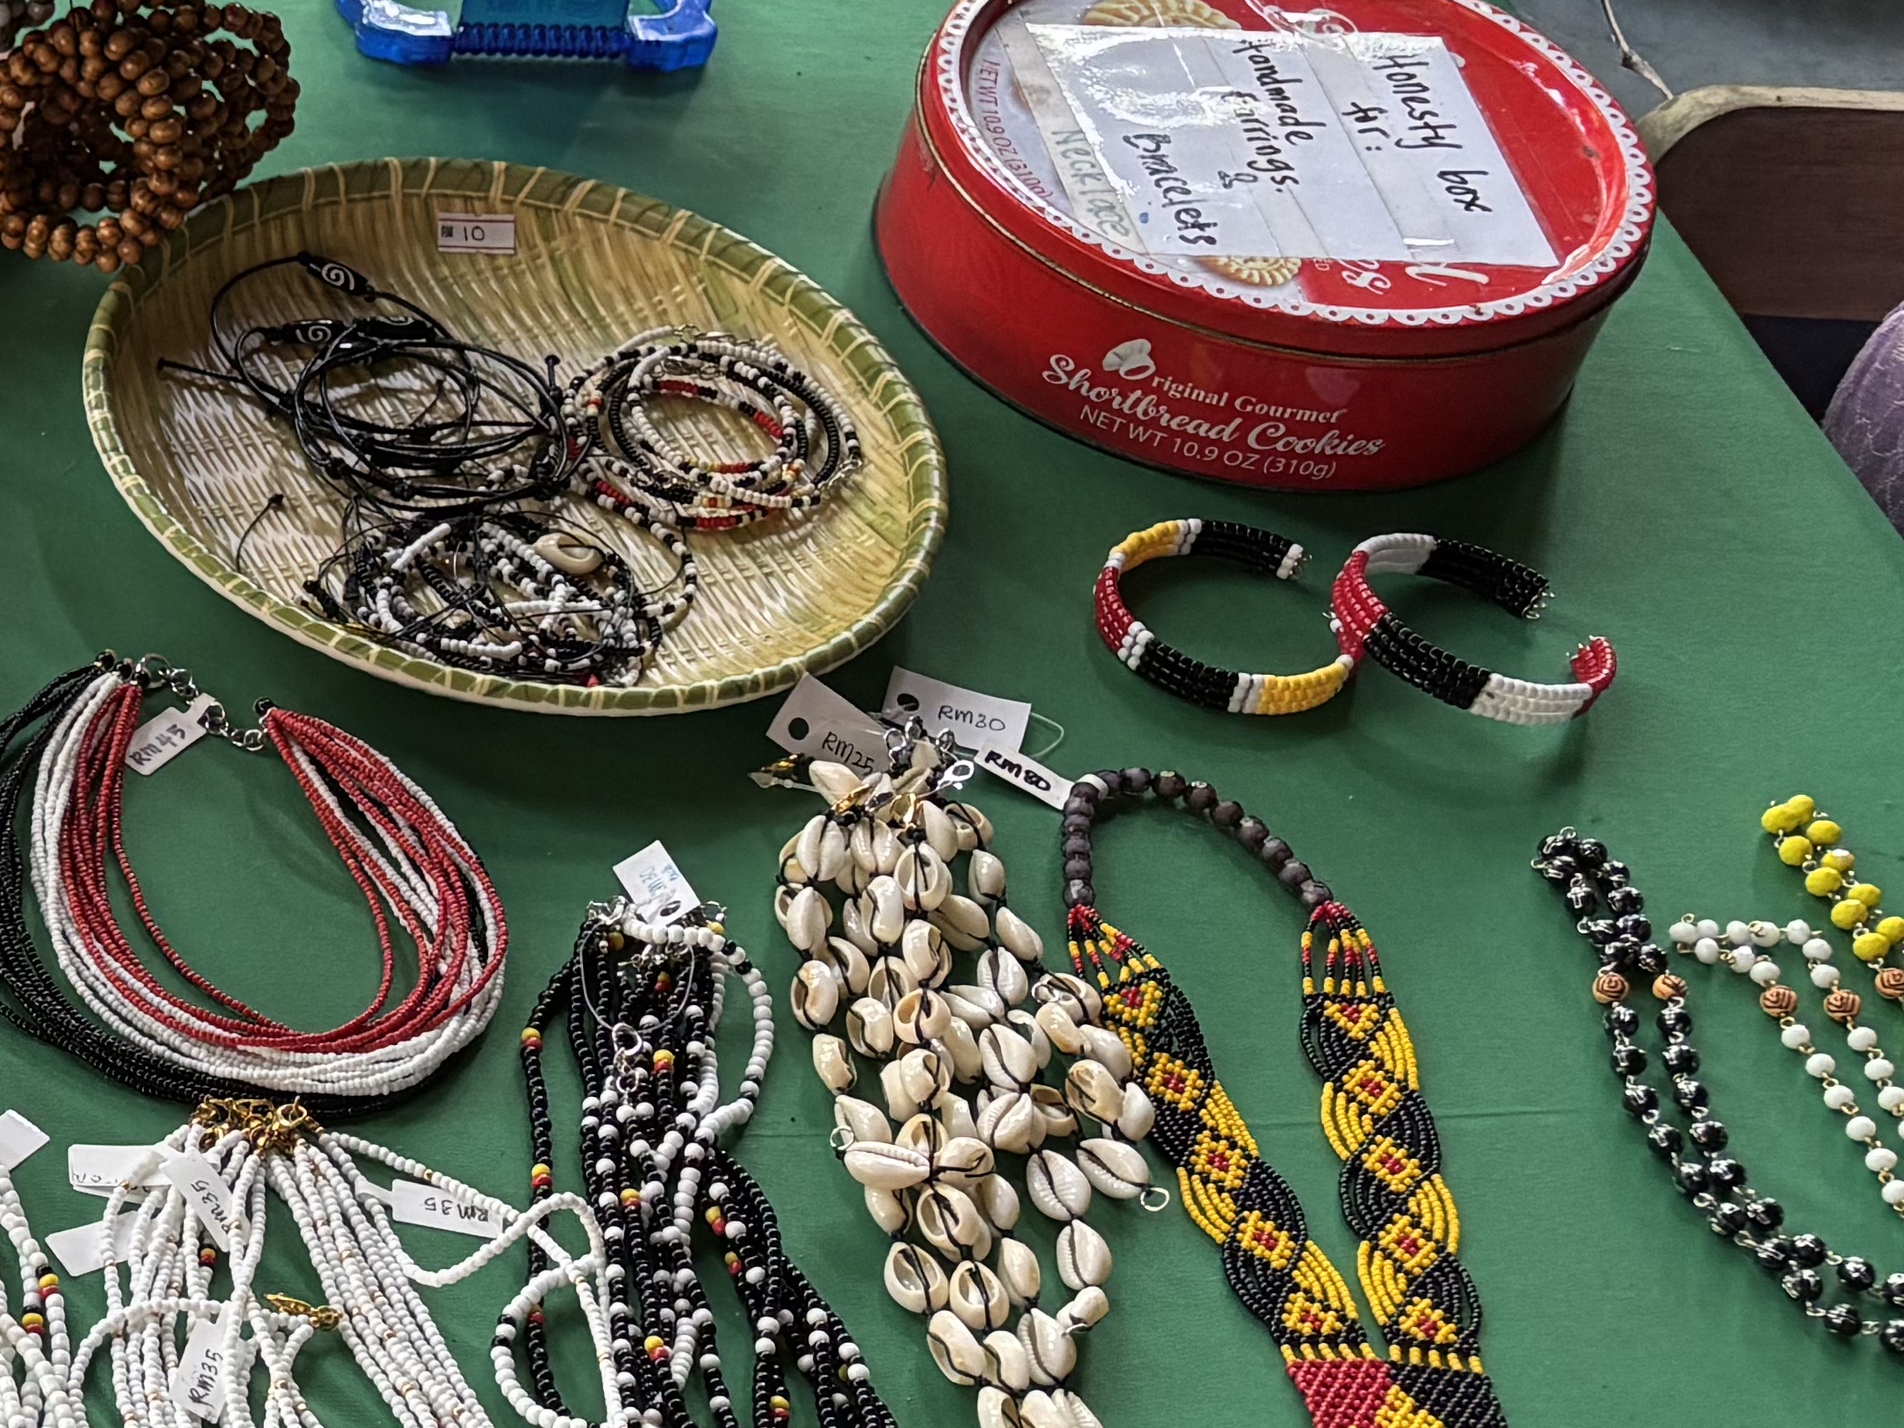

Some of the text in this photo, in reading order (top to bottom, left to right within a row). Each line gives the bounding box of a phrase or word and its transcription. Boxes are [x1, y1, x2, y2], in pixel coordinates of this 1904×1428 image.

[978, 85, 998, 107] WT
[981, 110, 1005, 134] 10.9
[1372, 54, 1463, 151] Honesty
[1437, 169, 1492, 213] box
[993, 136, 1018, 156] OZ
[1122, 133, 1218, 246] Bracelets
[463, 225, 485, 242] 10
[1042, 354, 1386, 457] Shortbread Cookies
[1234, 395, 1348, 425] Gourmet
[1080, 405, 1337, 481] NET WT 10.9 OZ (310g)
[128, 723, 186, 766] RM45
[821, 731, 876, 775] RM25
[985, 750, 1051, 792] RM80
[189, 1348, 224, 1406] RM35
